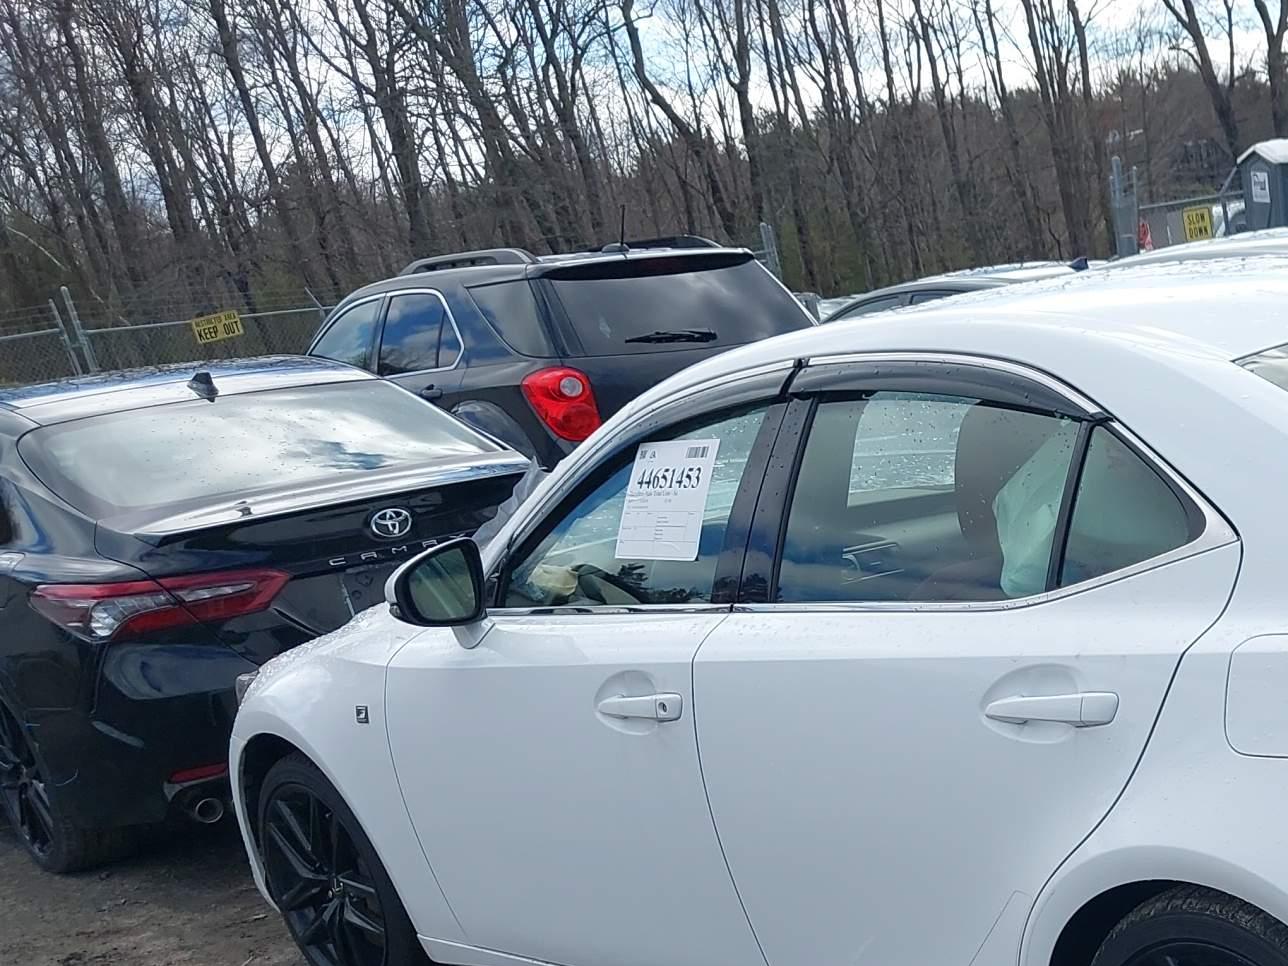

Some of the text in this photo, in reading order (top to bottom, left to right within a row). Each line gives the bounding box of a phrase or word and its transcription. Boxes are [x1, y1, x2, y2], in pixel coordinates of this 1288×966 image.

[1187, 213, 1206, 225] SLOW
[1189, 226, 1209, 238] DOWN
[196, 320, 240, 342] KEEP OUT
[637, 466, 702, 489] 44651453
